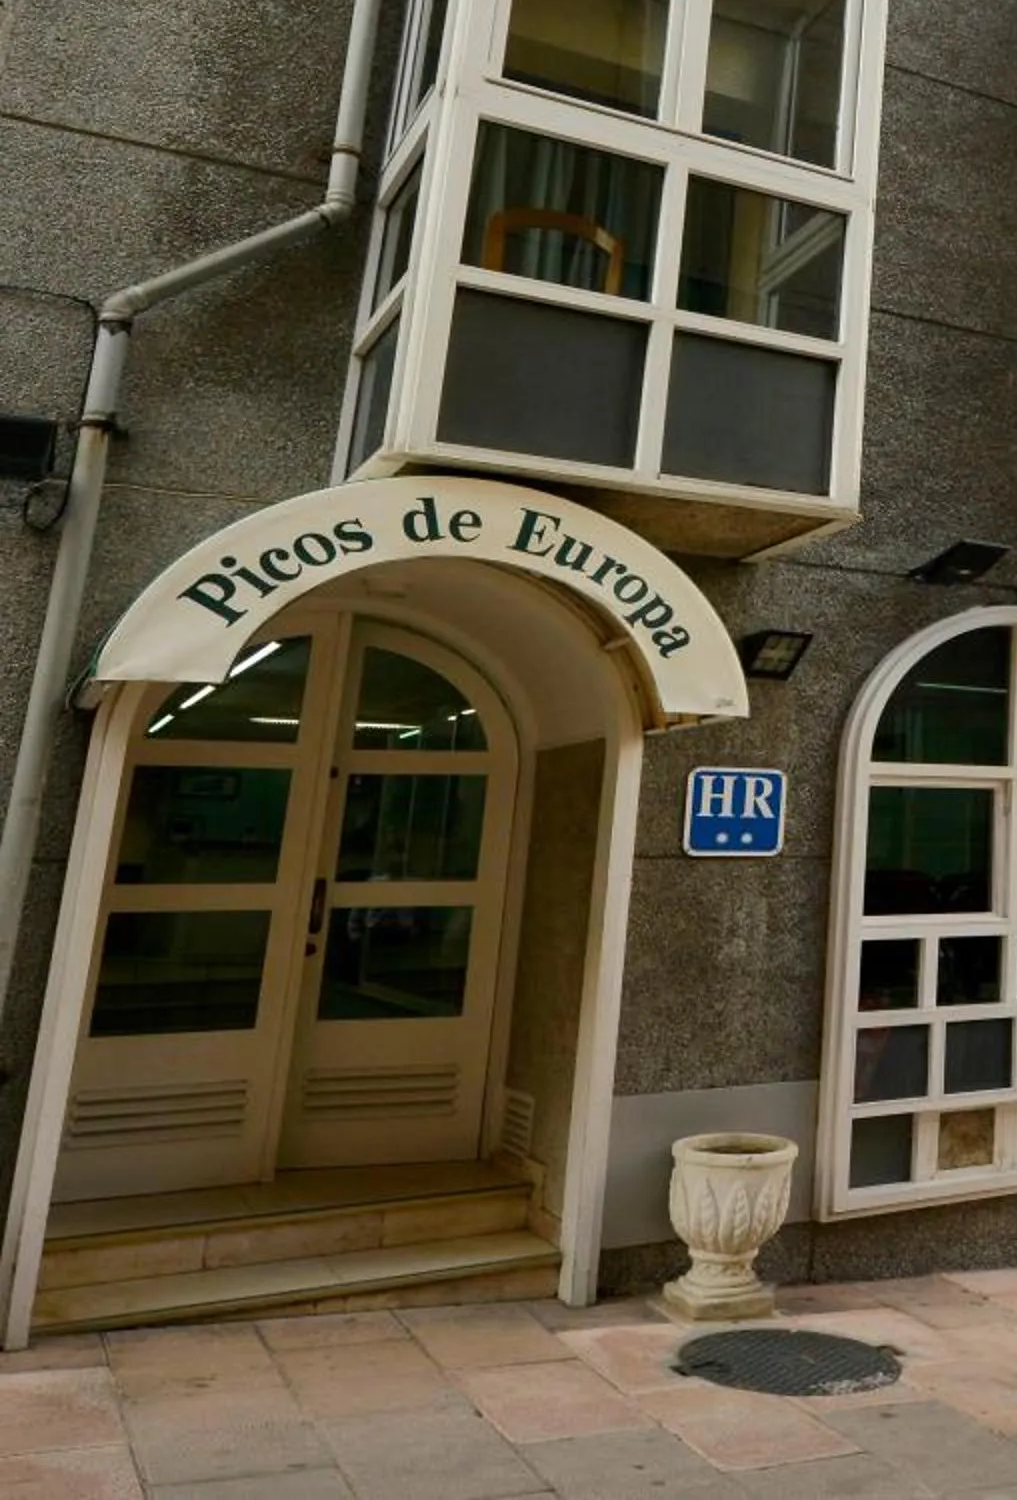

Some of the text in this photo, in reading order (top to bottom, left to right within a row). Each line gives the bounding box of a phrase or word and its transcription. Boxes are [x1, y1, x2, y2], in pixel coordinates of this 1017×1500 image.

[176, 496, 691, 659] Picos de Europa
[695, 775, 776, 819] HR
